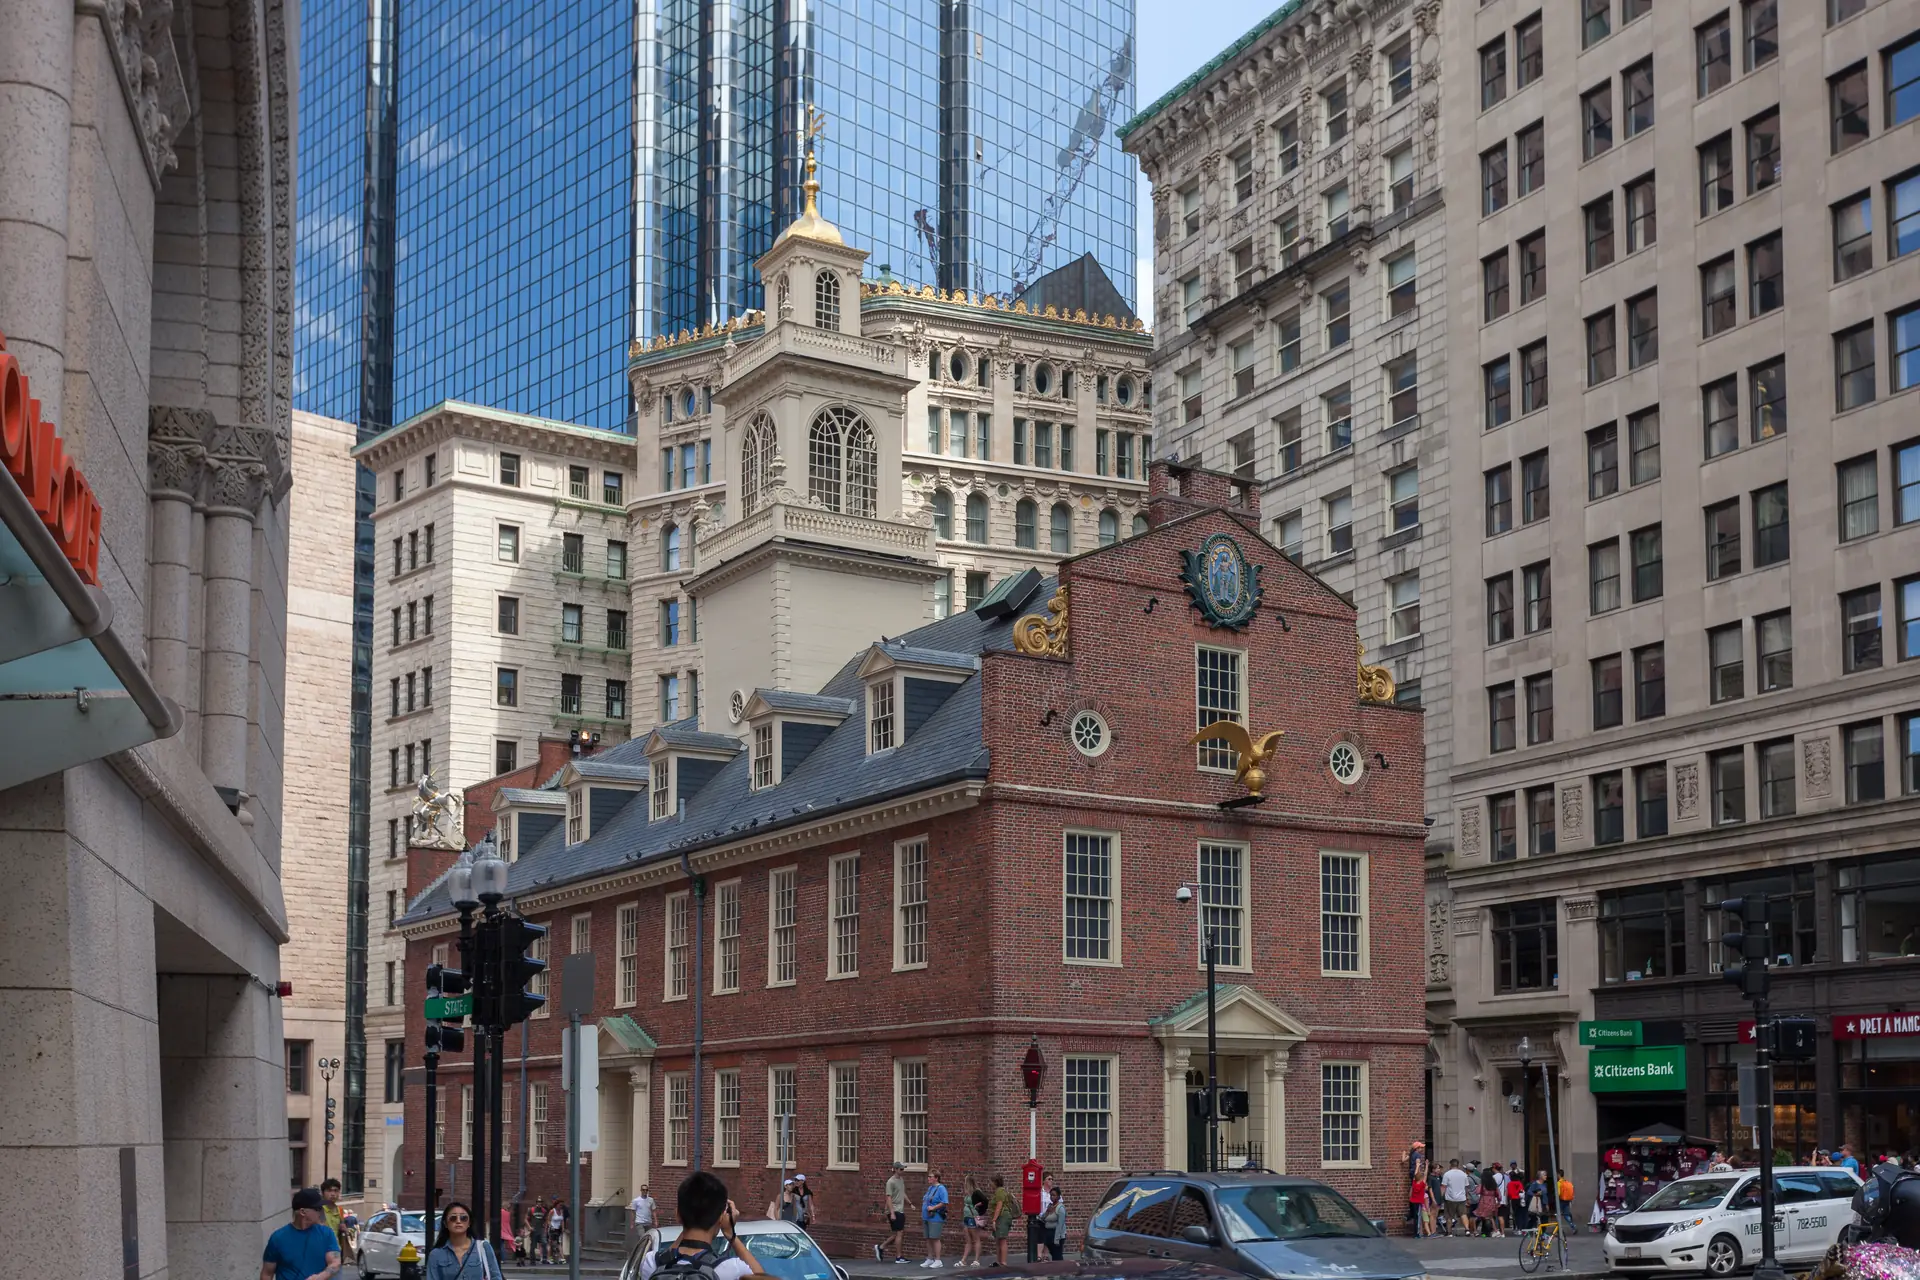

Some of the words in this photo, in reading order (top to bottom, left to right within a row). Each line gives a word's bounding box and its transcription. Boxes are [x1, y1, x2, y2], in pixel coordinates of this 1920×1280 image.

[0, 330, 41, 498] ON
[41, 422, 103, 589] HOTEL
[444, 1000, 463, 1015] STATE
[1598, 1028, 1619, 1037] Citizens
[1620, 1028, 1633, 1037] Bank
[1859, 1017, 1882, 1034] PRET
[1884, 1017, 1891, 1033] A
[1604, 1064, 1646, 1078] Citizens
[1647, 1061, 1674, 1076] Bank
